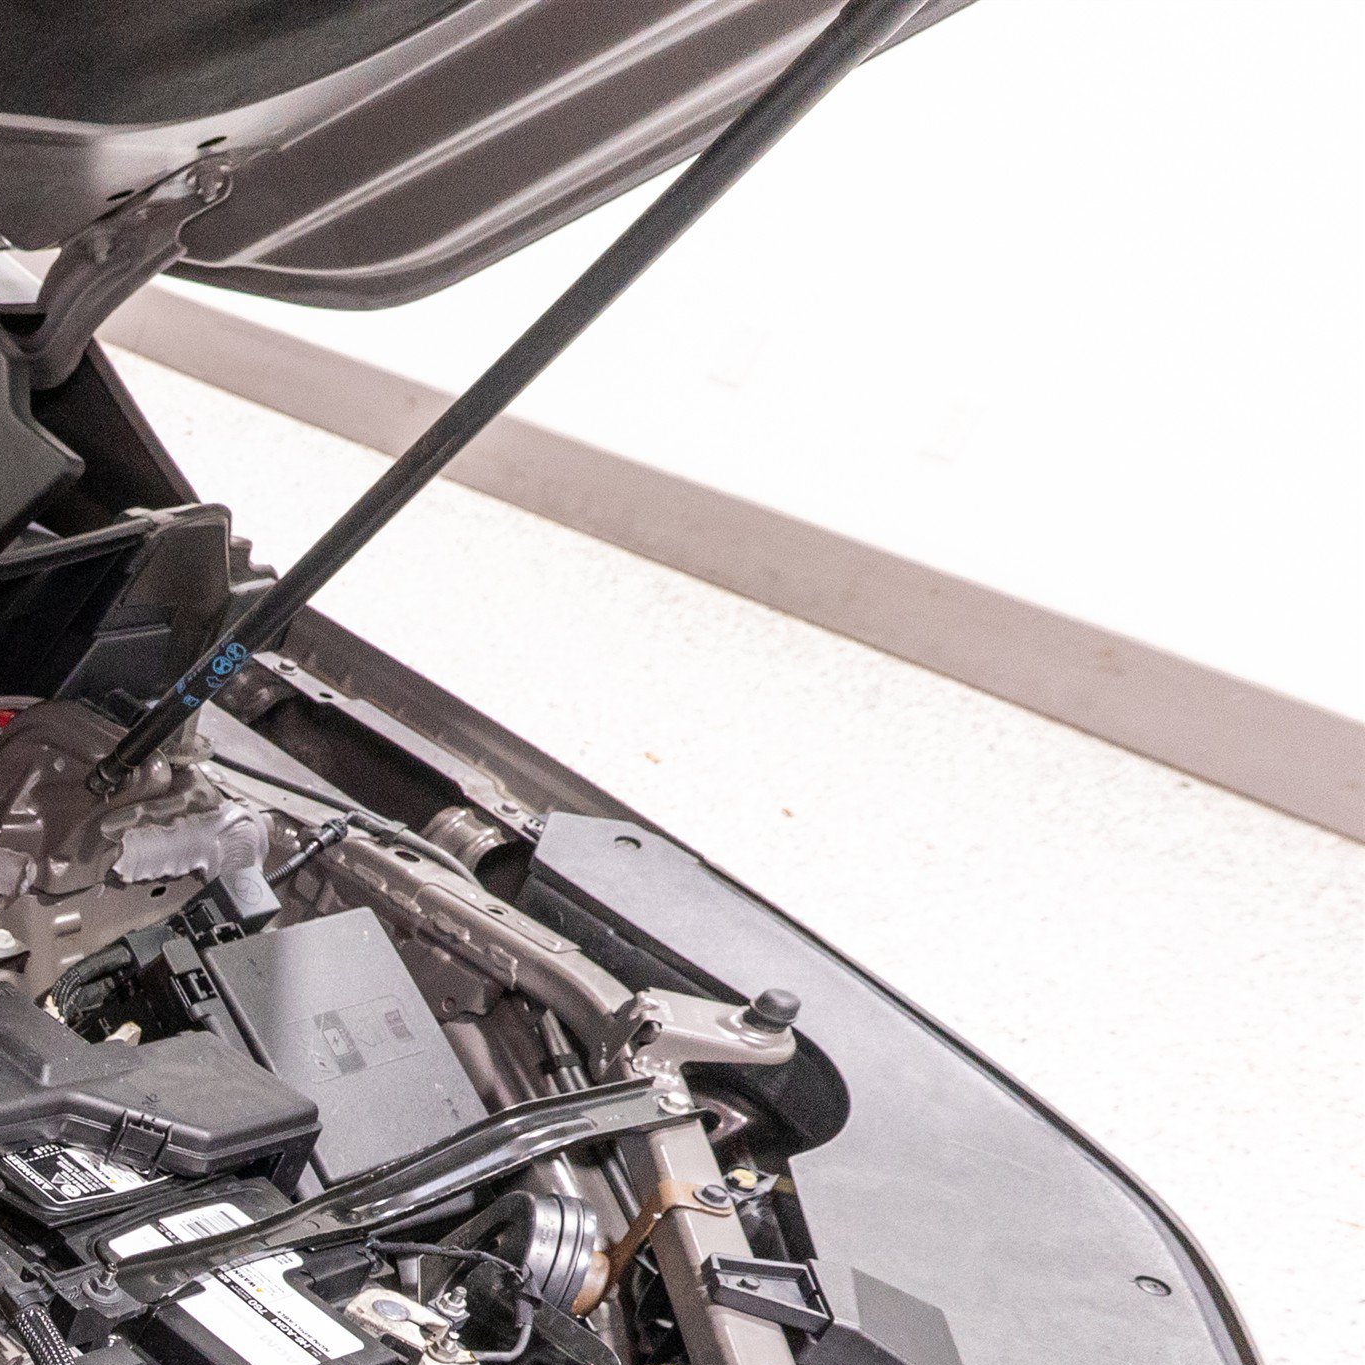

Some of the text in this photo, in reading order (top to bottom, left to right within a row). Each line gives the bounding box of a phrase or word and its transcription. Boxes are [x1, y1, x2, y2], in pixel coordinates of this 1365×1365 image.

[5, 1154, 46, 1184] DANGER
[247, 1298, 268, 1314] 760
[270, 1317, 311, 1348] H6-AGM
